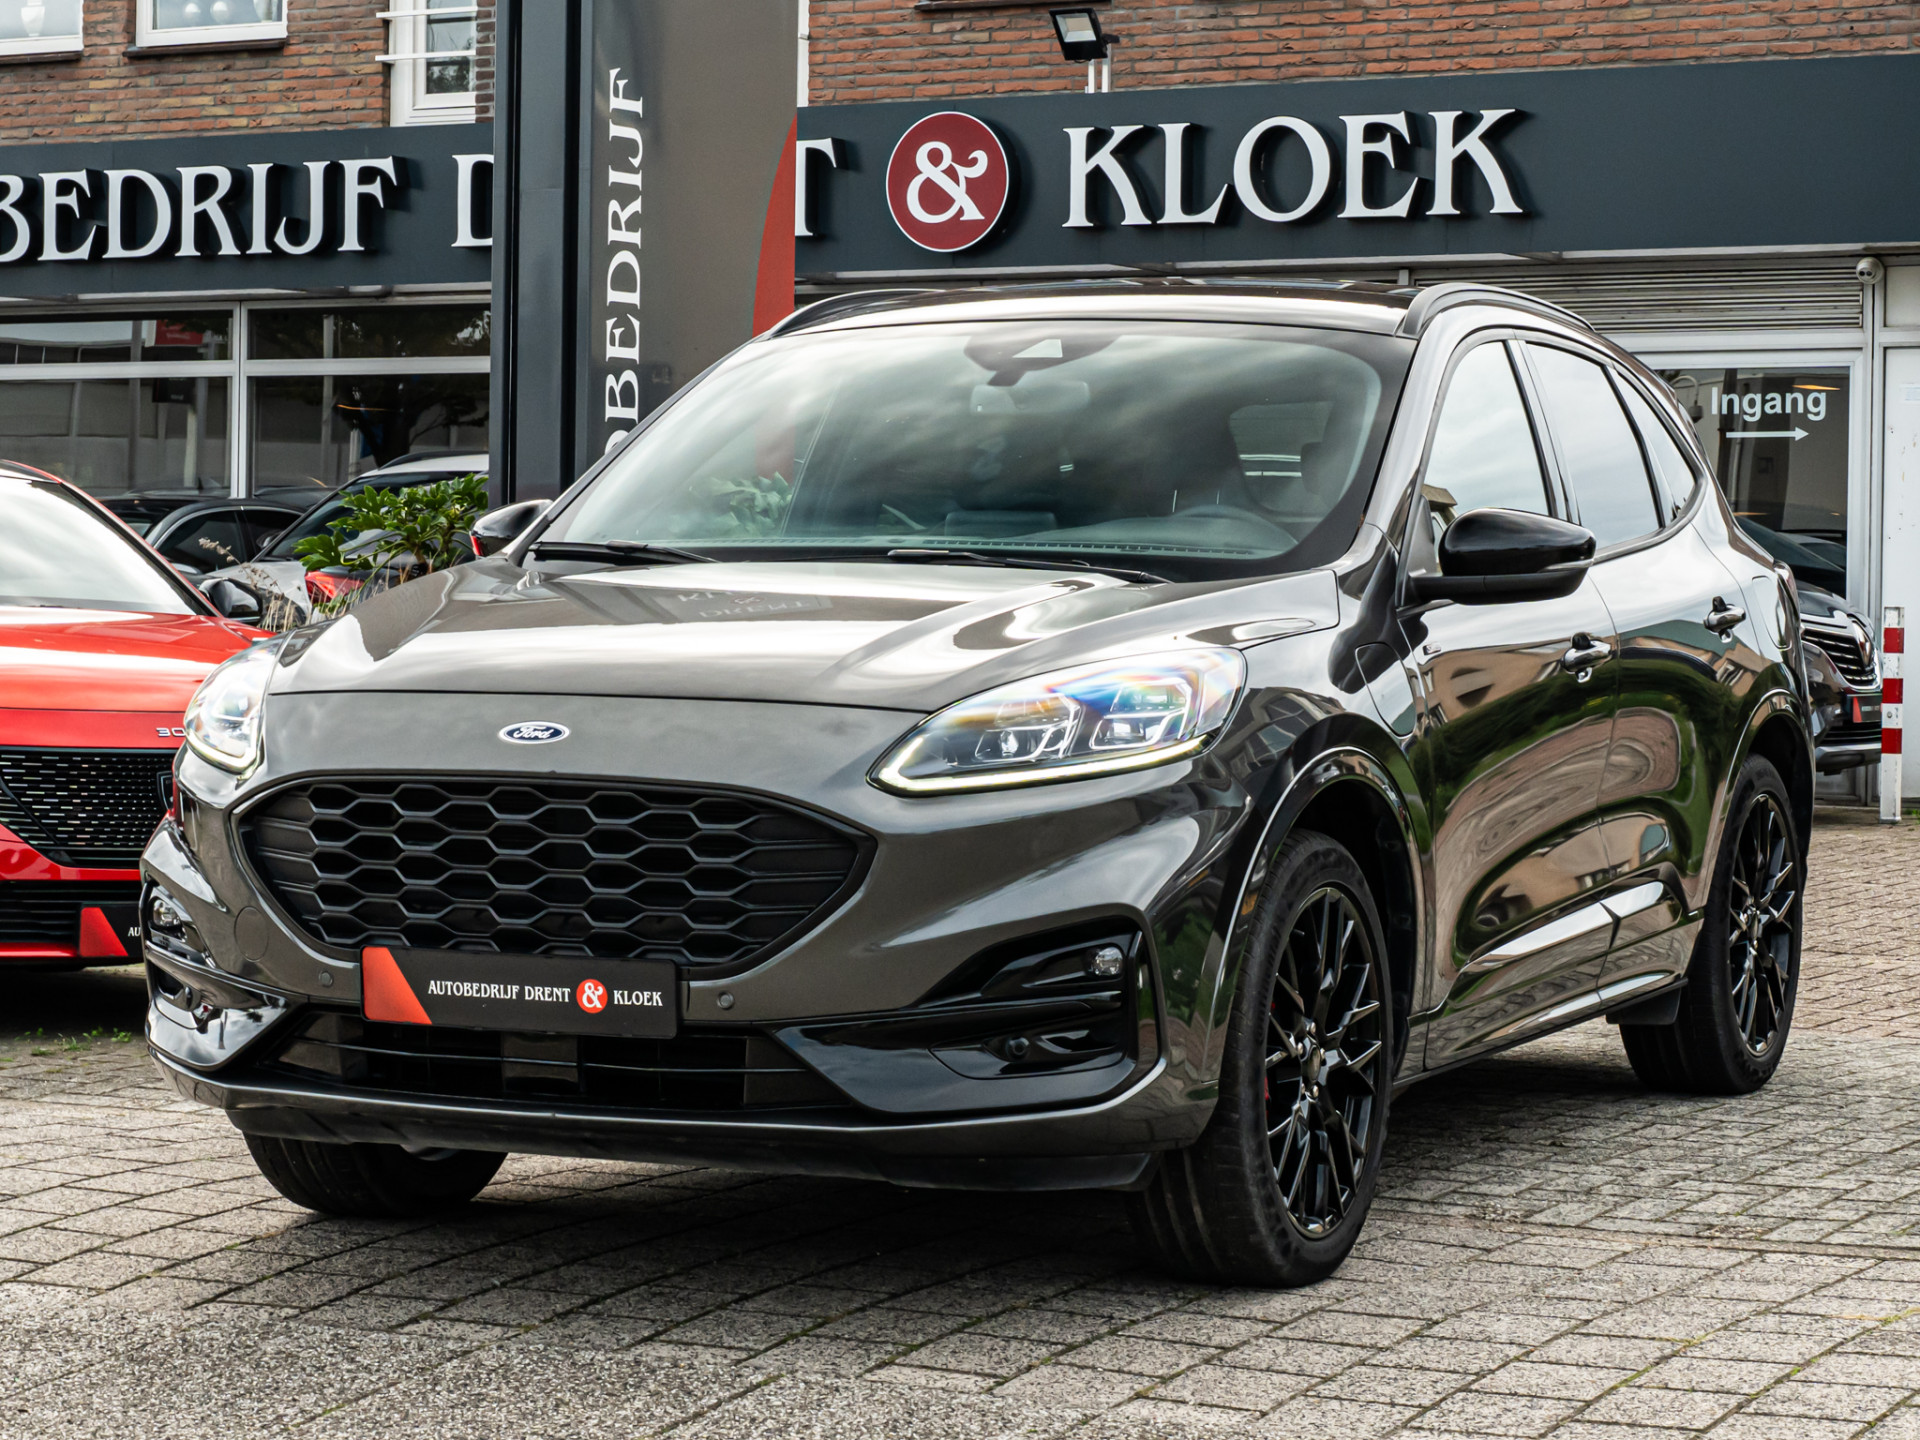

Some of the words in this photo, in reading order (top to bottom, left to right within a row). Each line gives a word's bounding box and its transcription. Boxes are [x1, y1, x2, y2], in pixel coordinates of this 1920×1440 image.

[906, 141, 989, 224] &
[1062, 108, 1525, 229] KLOEK
[1711, 386, 1827, 422] Ingang
[513, 725, 555, 739] Ford
[428, 979, 520, 1000] AUTOBEDRIJF
[524, 985, 571, 1003] DRENT
[582, 981, 604, 1009] &
[613, 989, 664, 1007] KLOEK
